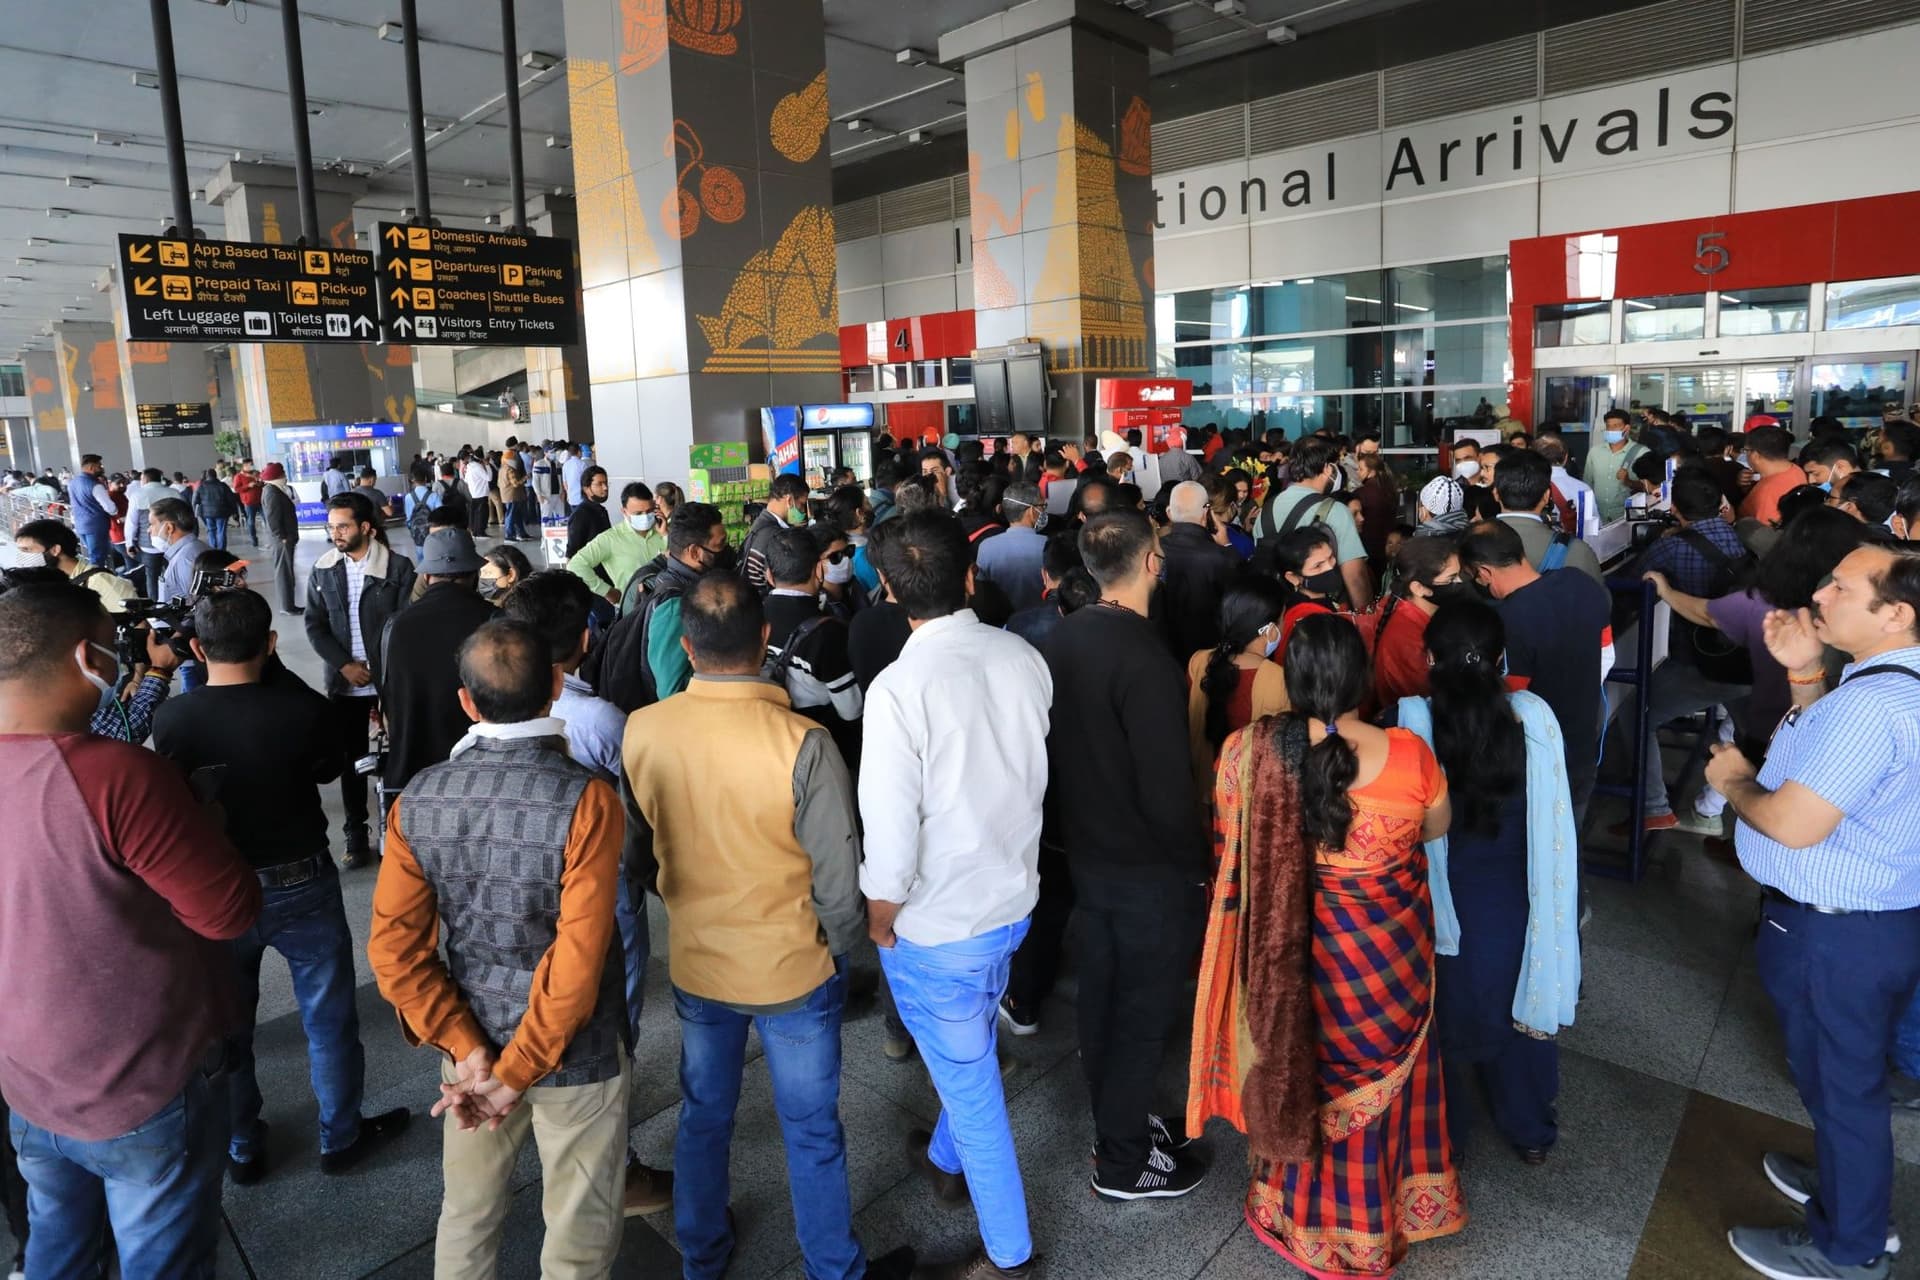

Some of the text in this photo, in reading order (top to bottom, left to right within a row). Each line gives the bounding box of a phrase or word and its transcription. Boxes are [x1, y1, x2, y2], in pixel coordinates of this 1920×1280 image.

[1385, 87, 1734, 191] Arrivals
[432, 230, 528, 247] Domestic Arrivals
[193, 243, 297, 261] App Based Taxi
[333, 252, 369, 265] Metro
[1693, 232, 1730, 275] 5
[434, 260, 496, 274] Departures
[525, 266, 562, 279] Parking
[194, 276, 282, 292] Prepaid Taxi
[321, 283, 367, 298] Pick-up
[438, 289, 486, 301] Coaches
[493, 292, 564, 304] Shuttle Buses
[143, 308, 240, 325] Left Luggage
[280, 312, 323, 325] Toilets
[439, 317, 555, 330] Visitors Entry Tickets
[895, 329, 909, 352] 4
